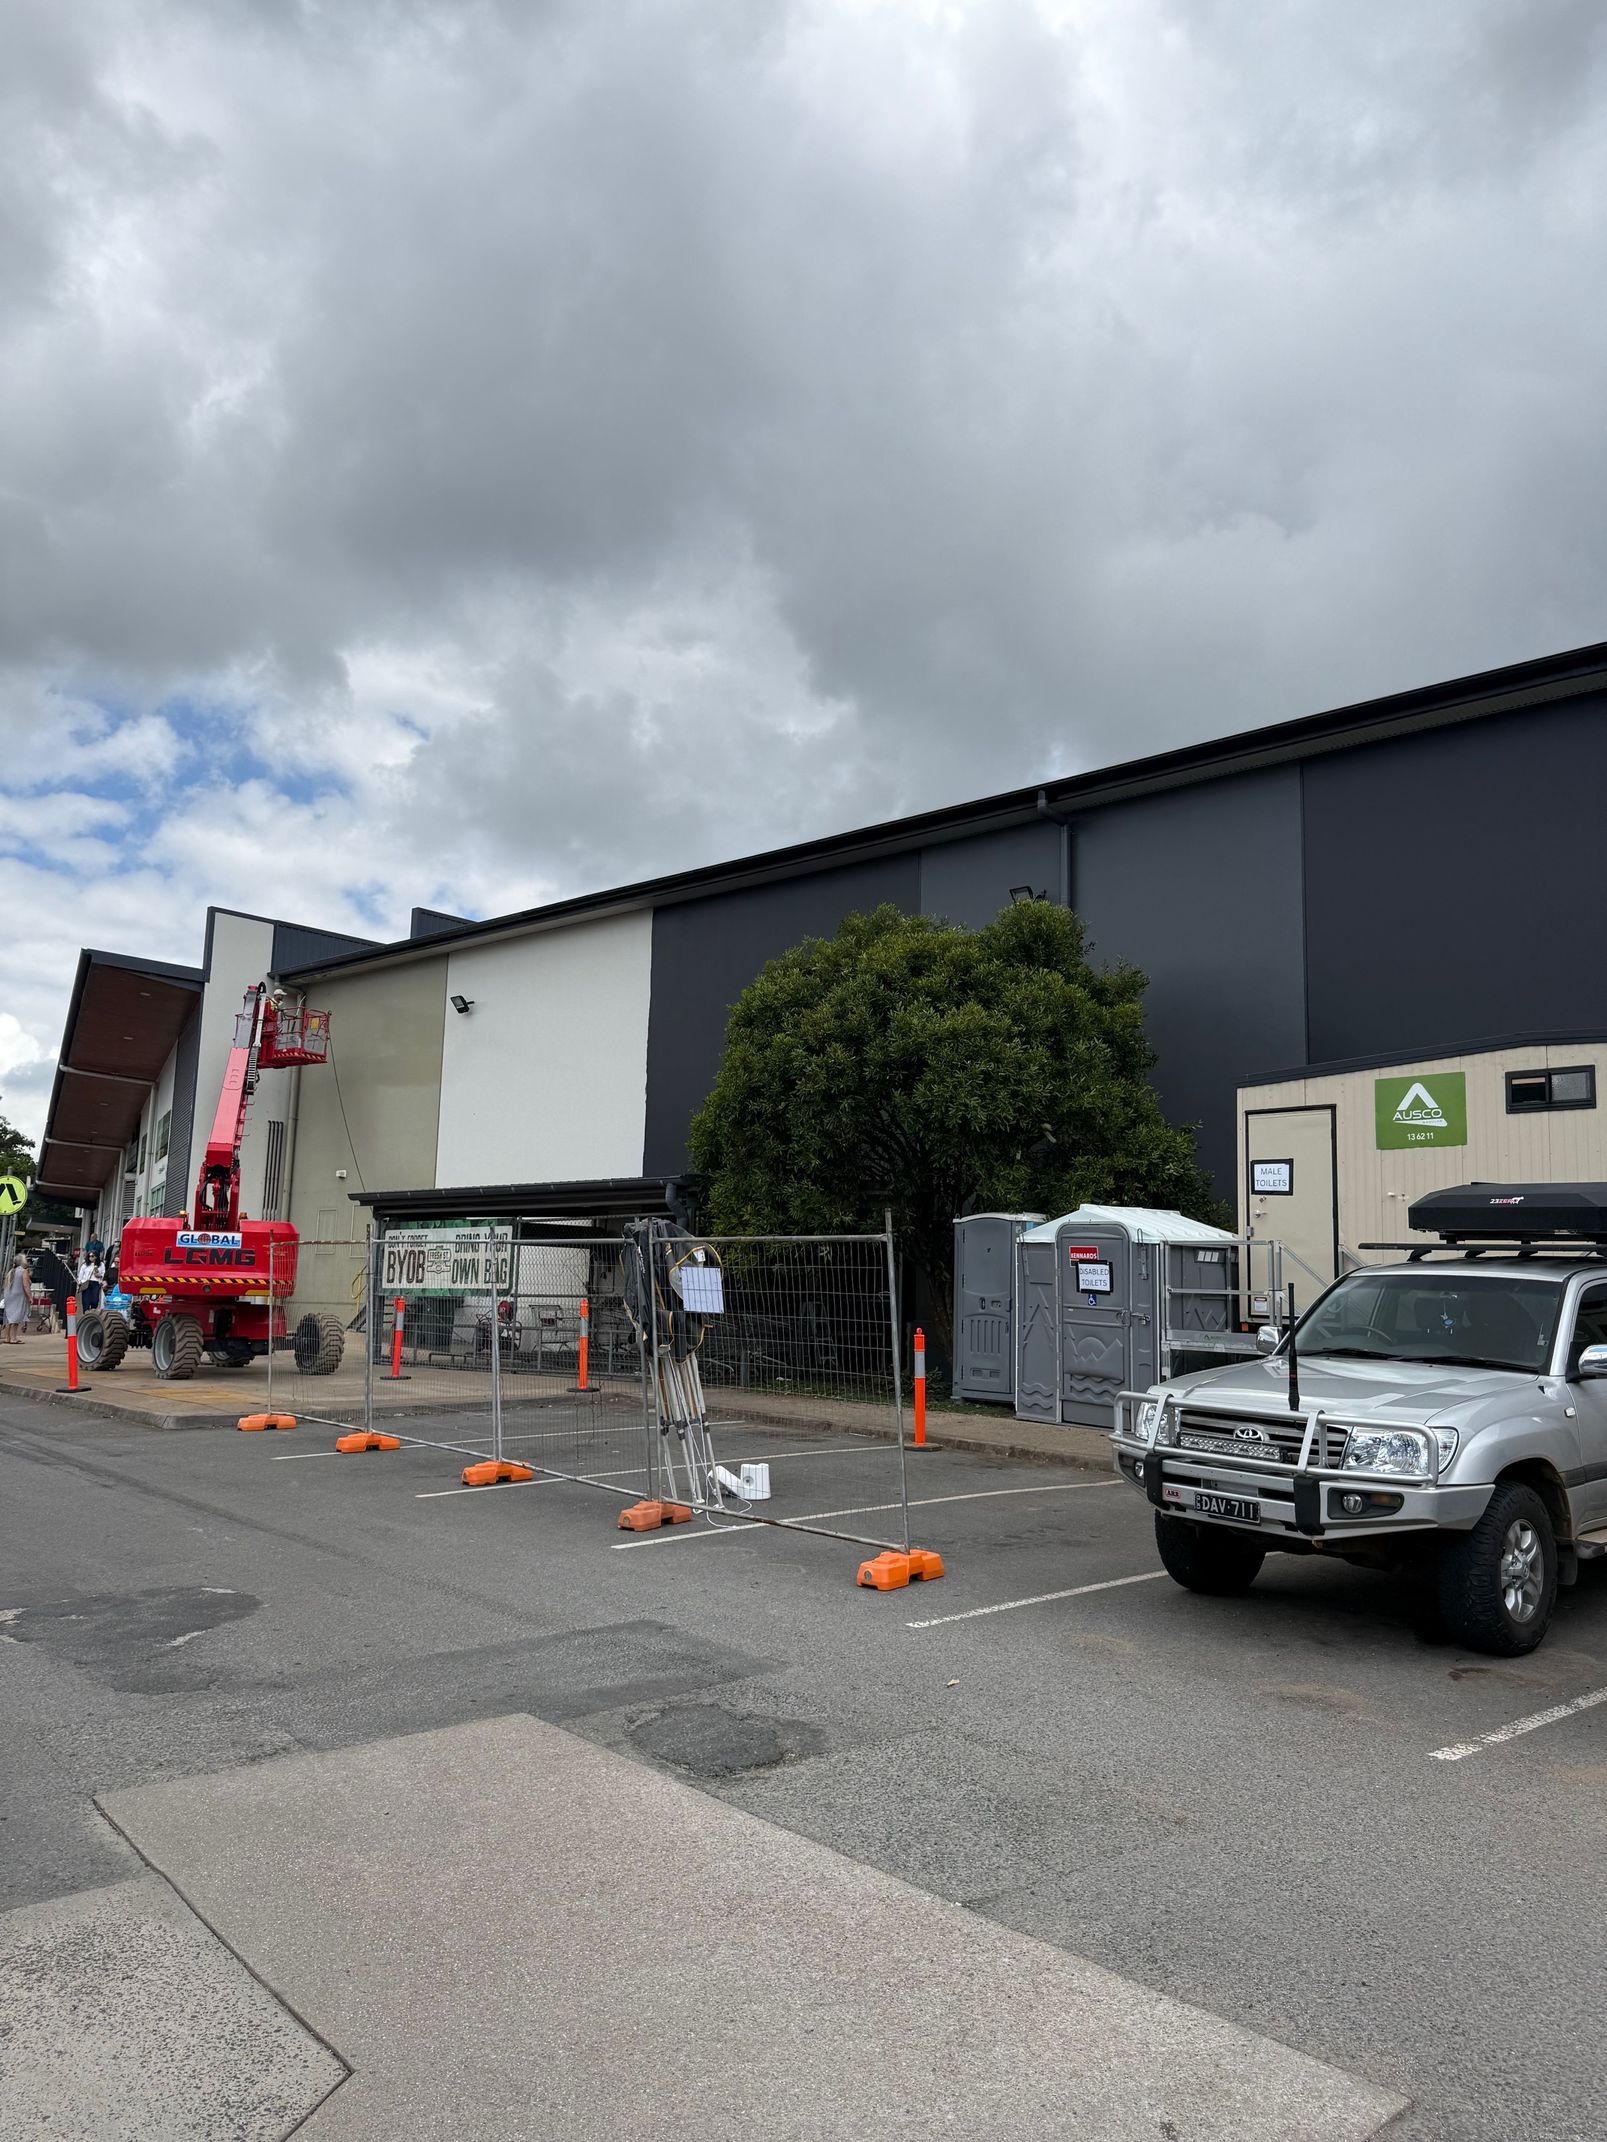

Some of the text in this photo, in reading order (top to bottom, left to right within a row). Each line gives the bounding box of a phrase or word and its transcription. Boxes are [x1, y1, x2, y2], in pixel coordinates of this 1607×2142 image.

[1392, 1109, 1442, 1121] AUSCO
[1260, 1167, 1282, 1175] MALE
[1256, 1179, 1287, 1187] TOILETS
[179, 1233, 239, 1245] GLOBAL
[484, 1232, 508, 1253] YUR
[164, 1247, 256, 1266] LGMG
[386, 1249, 426, 1284] BYOB
[452, 1258, 480, 1284] OWN
[1080, 1268, 1109, 1276] DISABLED
[1082, 1279, 1108, 1287] TOILETS
